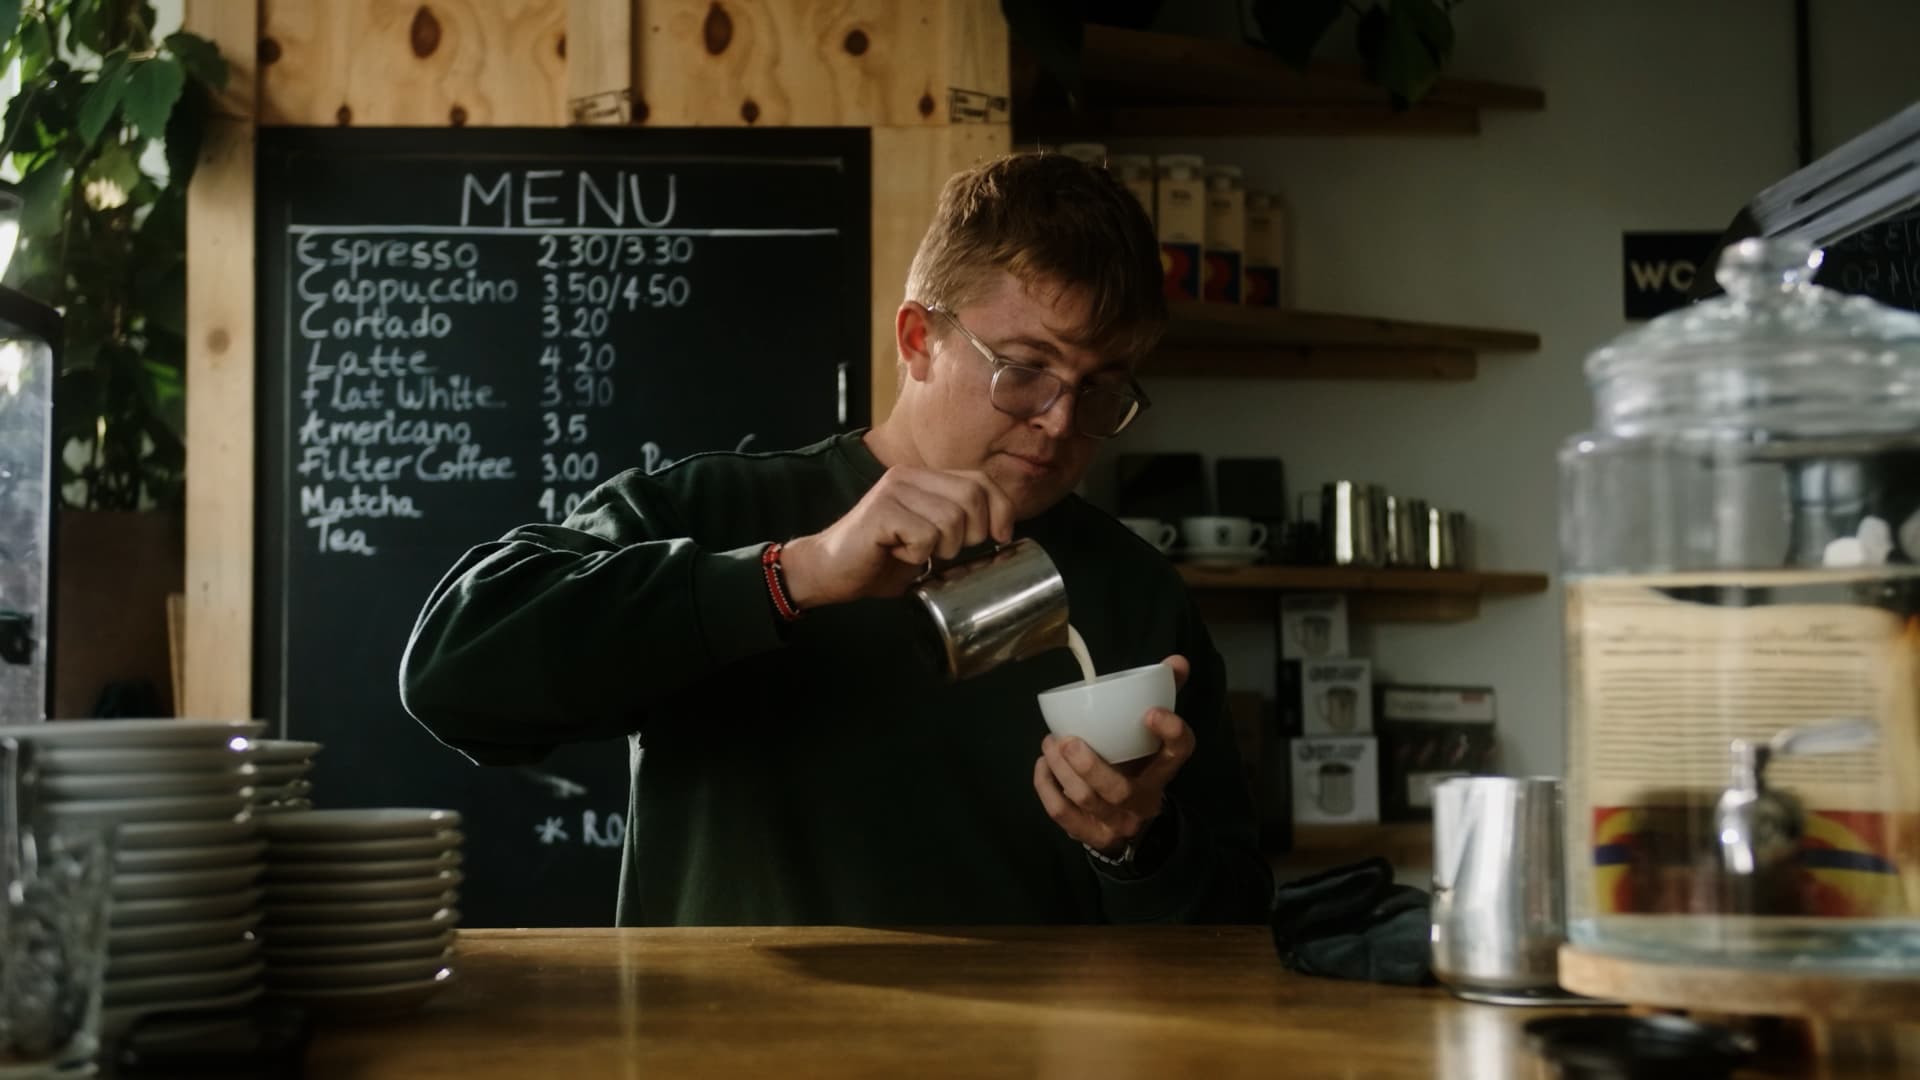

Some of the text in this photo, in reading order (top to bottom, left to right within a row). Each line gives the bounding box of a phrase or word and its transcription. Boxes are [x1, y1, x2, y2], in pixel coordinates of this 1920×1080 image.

[459, 169, 678, 227] MENU
[296, 234, 694, 280] Espresso 2.30/3.30
[1629, 260, 1696, 291] WC
[297, 271, 691, 317] Cappuccino 3.50/4.50
[299, 304, 610, 340] Cortado 3.20
[306, 340, 616, 377] Latte 4.20
[300, 367, 614, 411] Flat White 3.90
[298, 411, 588, 446] Americano 3.5
[297, 443, 599, 483] Filter Coffee 3.00
[300, 484, 424, 519] Matcha
[307, 511, 376, 555] Tea
